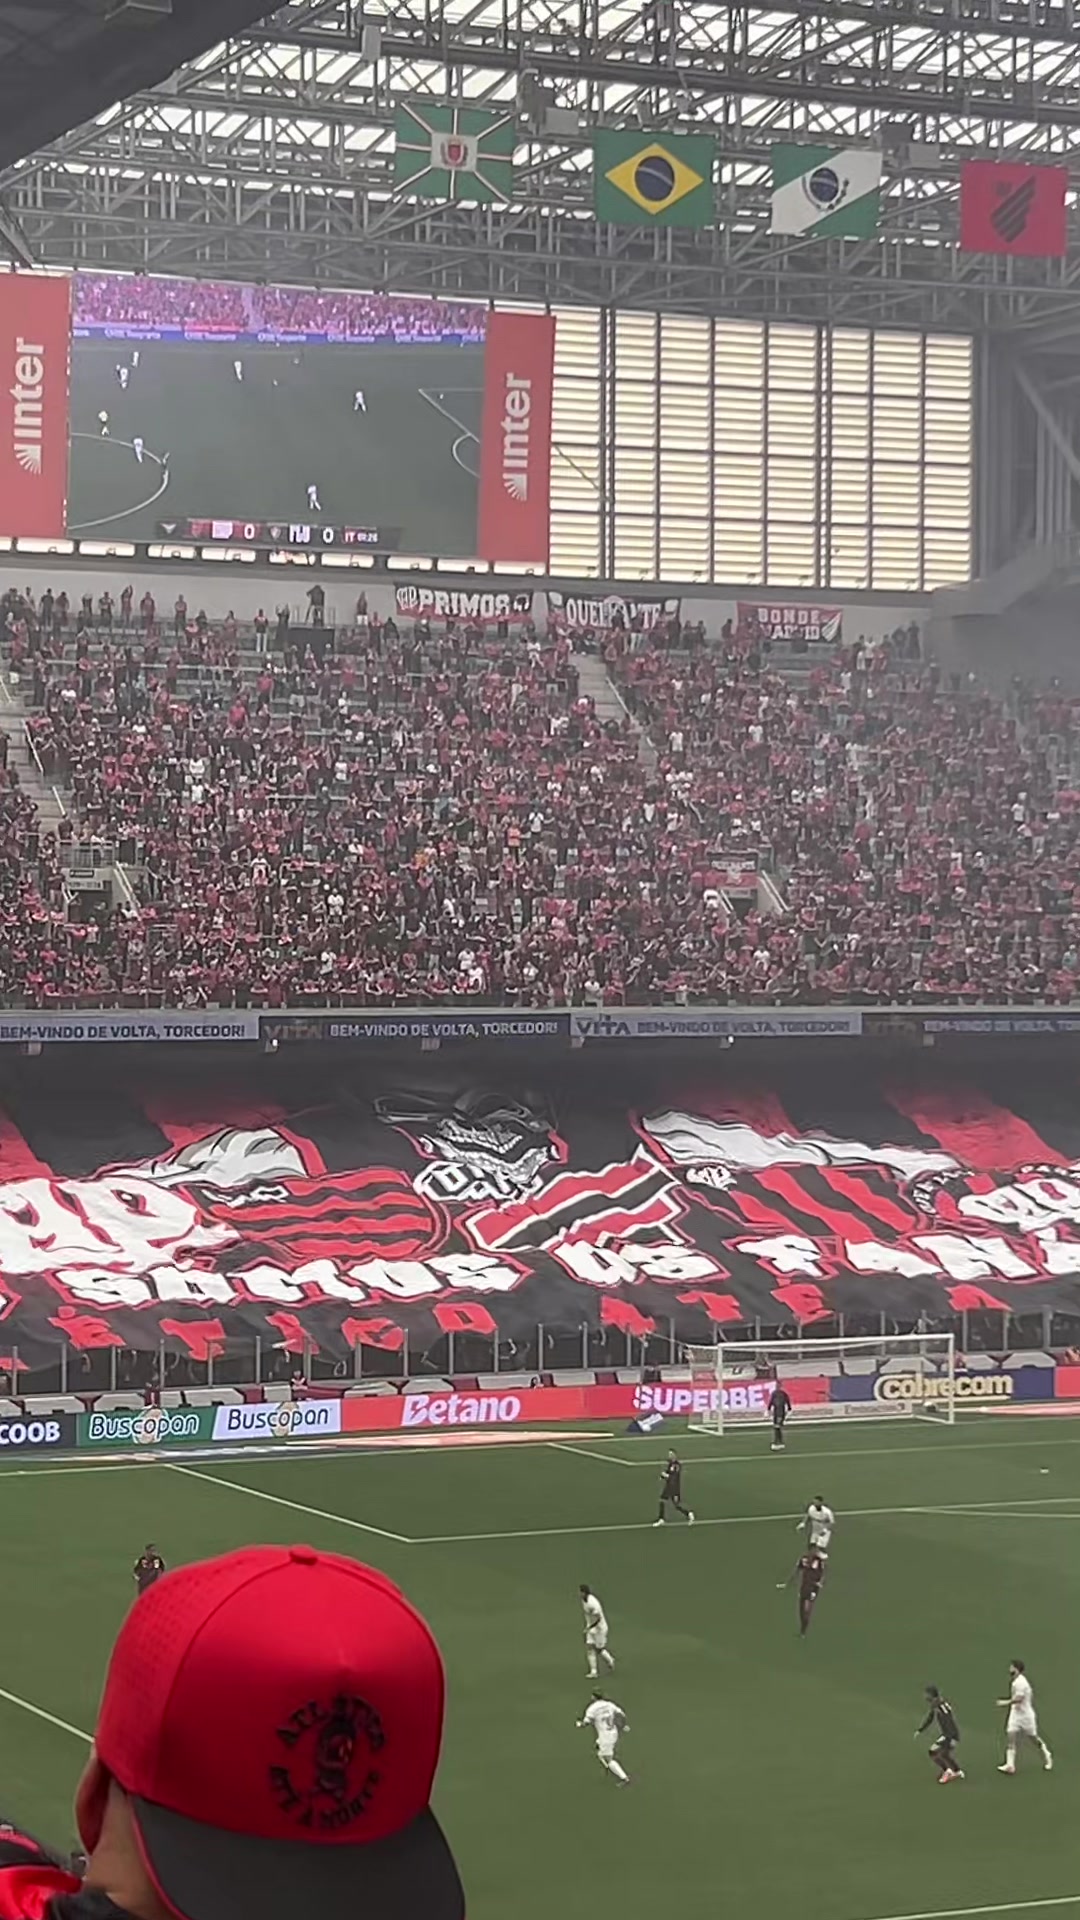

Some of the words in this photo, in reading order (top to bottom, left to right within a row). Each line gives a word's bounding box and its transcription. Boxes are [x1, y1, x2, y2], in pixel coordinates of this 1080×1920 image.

[244, 523, 255, 540] 0
[322, 527, 333, 543] 0
[419, 588, 510, 618] PRIMOS
[758, 608, 820, 625] BONDE
[87, 1025, 107, 1039] DE
[110, 1025, 160, 1040] VOLTA,
[163, 1024, 246, 1039] TORCEDOR!
[330, 1024, 408, 1038] BEM-VINDO
[410, 1024, 429, 1037] DE
[431, 1023, 479, 1038] VOLTA,
[482, 1021, 558, 1036] TORCEDOR!
[54, 1252, 523, 1305] SOMOS
[401, 1393, 521, 1427] Betano
[632, 1381, 778, 1413] SUPERBET
[89, 1411, 201, 1442] Buscopan
[227, 1406, 330, 1434] Buscopan
